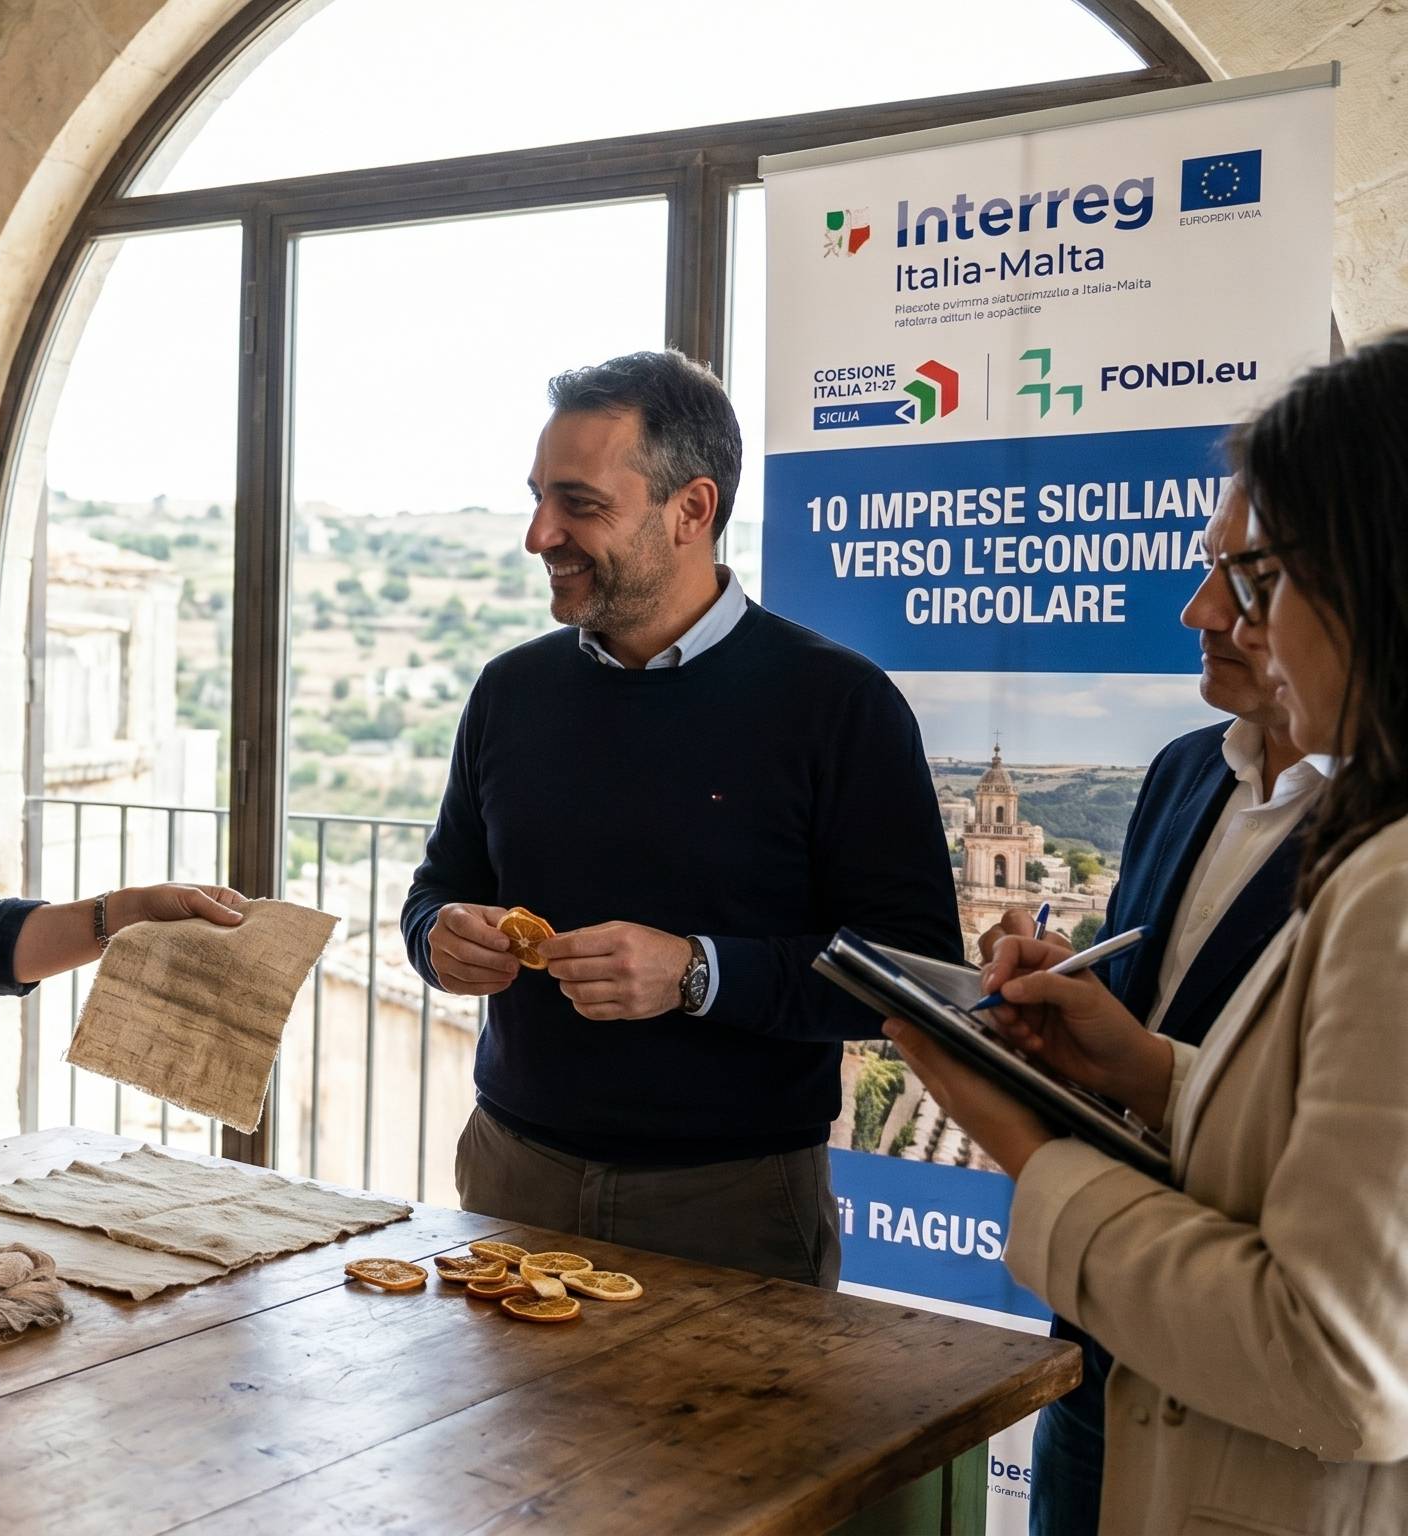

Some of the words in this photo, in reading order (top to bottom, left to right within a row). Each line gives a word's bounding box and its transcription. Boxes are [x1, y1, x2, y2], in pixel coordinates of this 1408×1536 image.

[896, 176, 1155, 248] Interreg
[895, 243, 1105, 292] Italia-Malta
[814, 364, 896, 383] COESIONE
[814, 383, 862, 399] ITALIA
[864, 380, 896, 393] 21-27
[1101, 359, 1257, 391] FONDI.eu
[818, 410, 860, 424] SICILIA
[807, 495, 847, 533] 10
[859, 486, 1026, 529] IMPRESE
[831, 538, 951, 579] VERSO
[905, 584, 1126, 625] CIRCOLARE
[869, 1201, 1005, 1261] RAGUS
